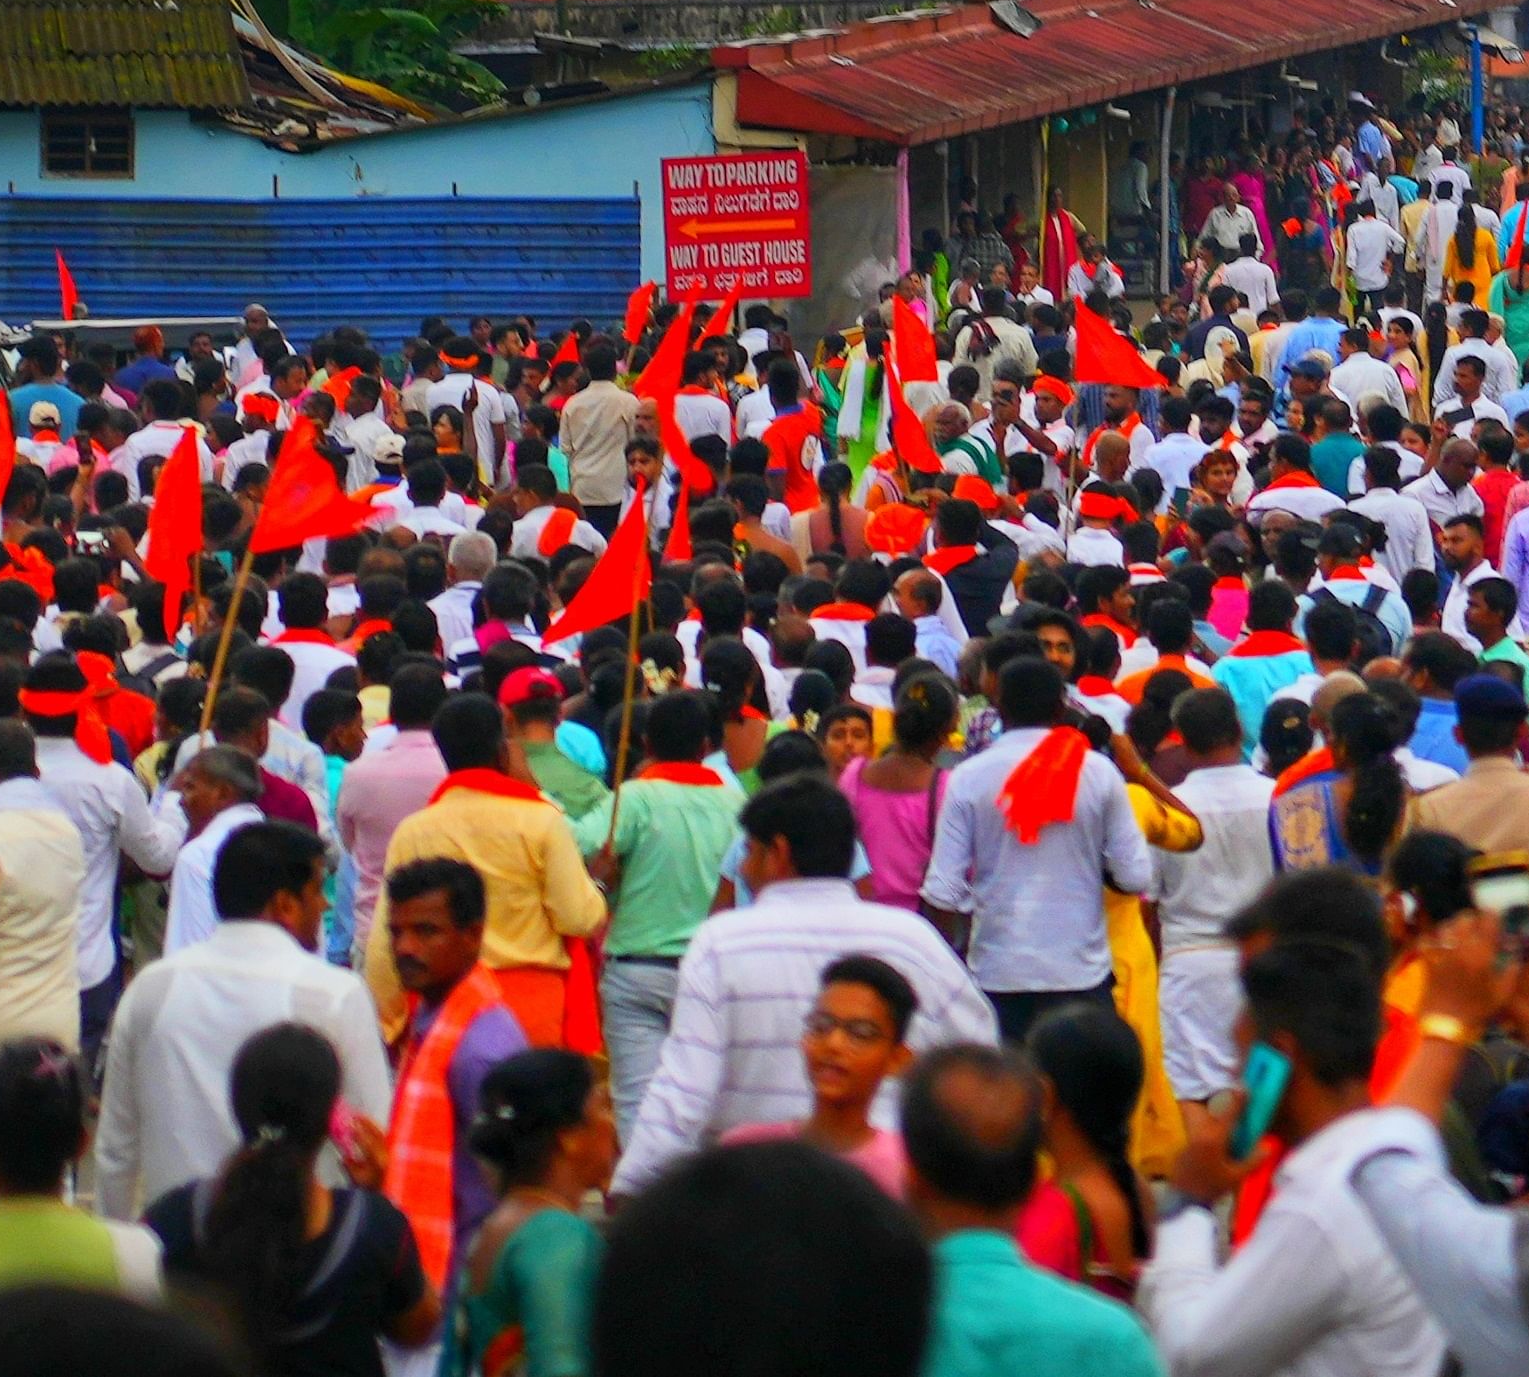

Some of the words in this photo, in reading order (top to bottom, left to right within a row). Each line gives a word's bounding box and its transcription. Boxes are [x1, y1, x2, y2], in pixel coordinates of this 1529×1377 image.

[668, 164, 704, 189] WAY
[705, 163, 726, 188] TO
[726, 159, 798, 187] PARKING
[670, 244, 699, 270] WAY
[701, 242, 720, 268] TO
[722, 241, 762, 268] GUEST
[763, 239, 806, 266] HOUSE
